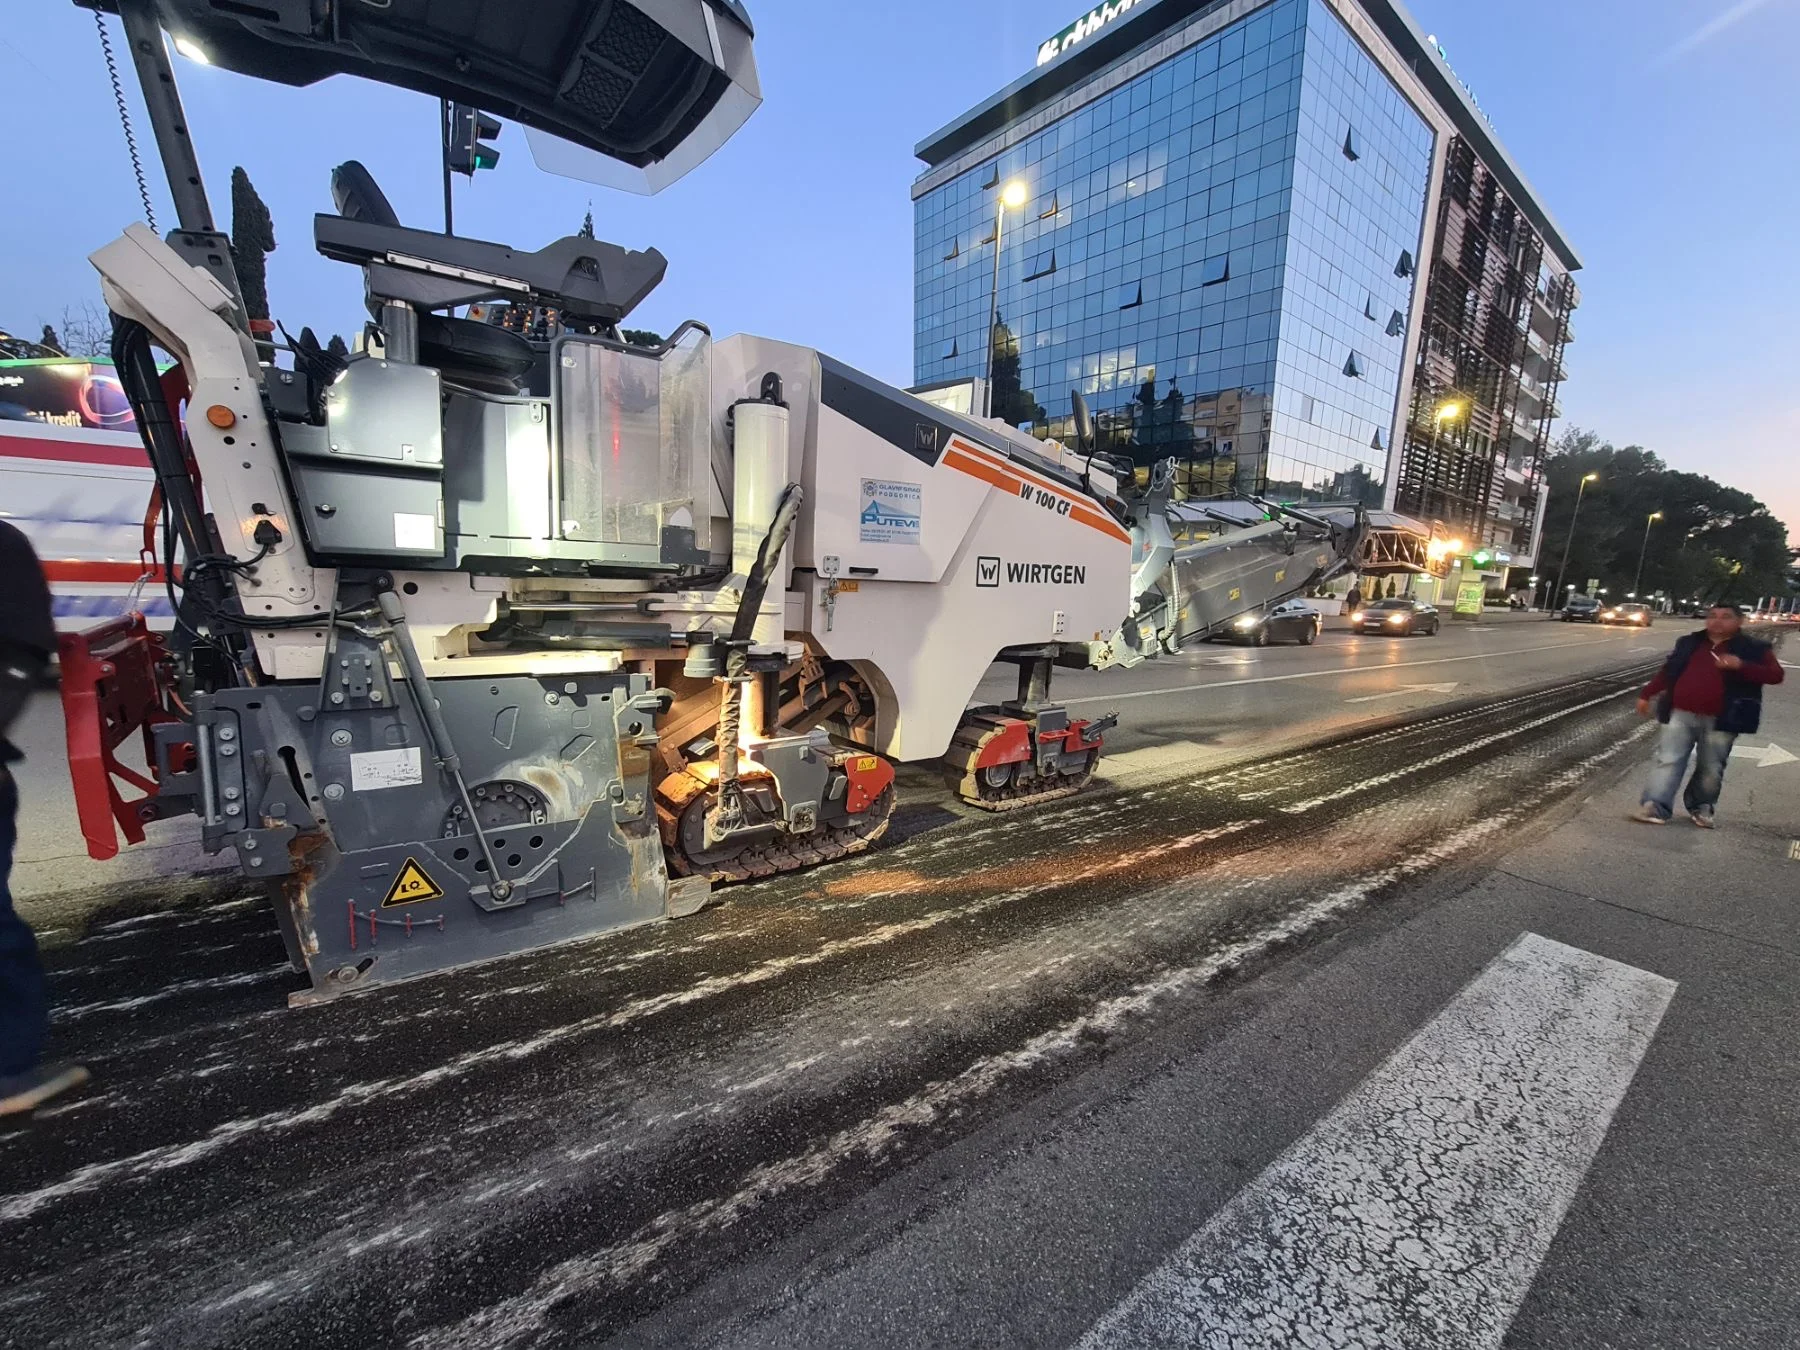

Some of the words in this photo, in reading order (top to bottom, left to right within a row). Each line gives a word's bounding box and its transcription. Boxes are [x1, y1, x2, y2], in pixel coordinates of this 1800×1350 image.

[46, 410, 82, 427] kredit
[878, 491, 921, 500] PODGORICA
[1020, 483, 1034, 500] W
[1035, 490, 1056, 510] 100
[1056, 500, 1071, 516] CF
[861, 512, 916, 528] PUTEVI
[1007, 562, 1086, 585] WIRTGEN
